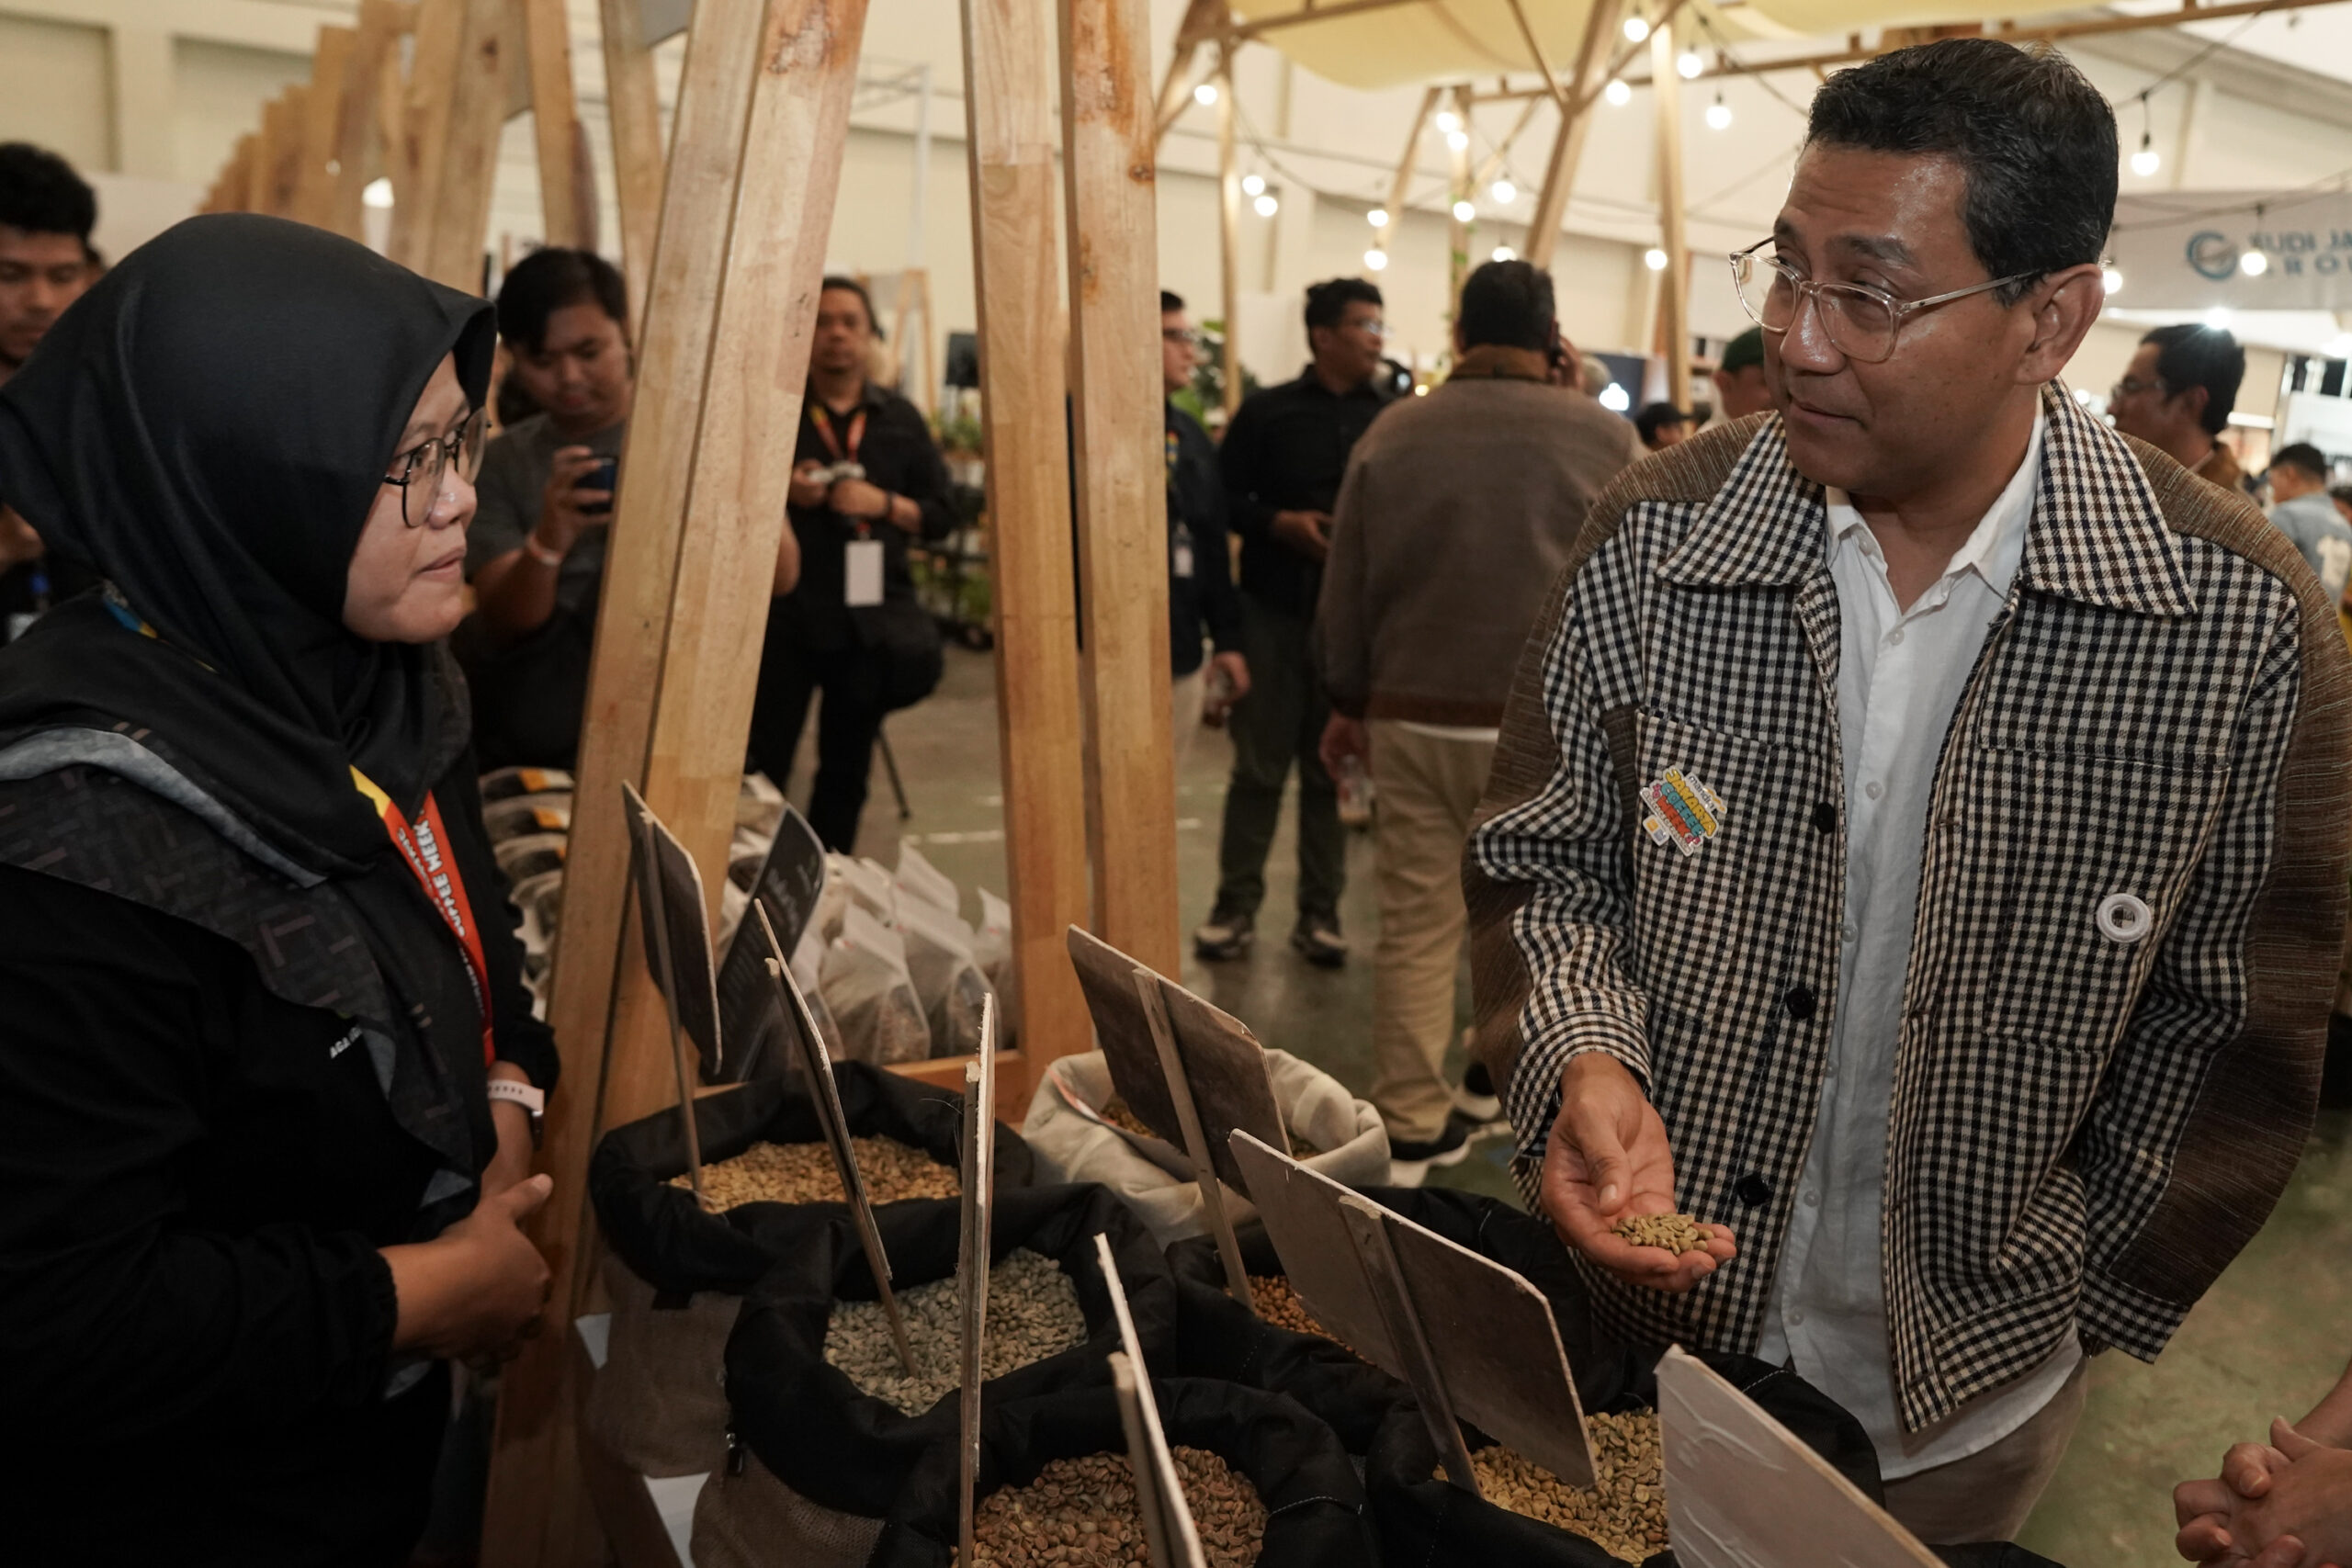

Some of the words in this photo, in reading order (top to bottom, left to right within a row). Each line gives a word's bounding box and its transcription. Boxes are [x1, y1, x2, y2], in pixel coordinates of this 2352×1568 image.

[1657, 795, 1691, 838] WEEK
[1661, 782, 1705, 837] COFFEE
[1665, 769, 1717, 837] JAKARTA
[412, 819, 443, 873] WEEK
